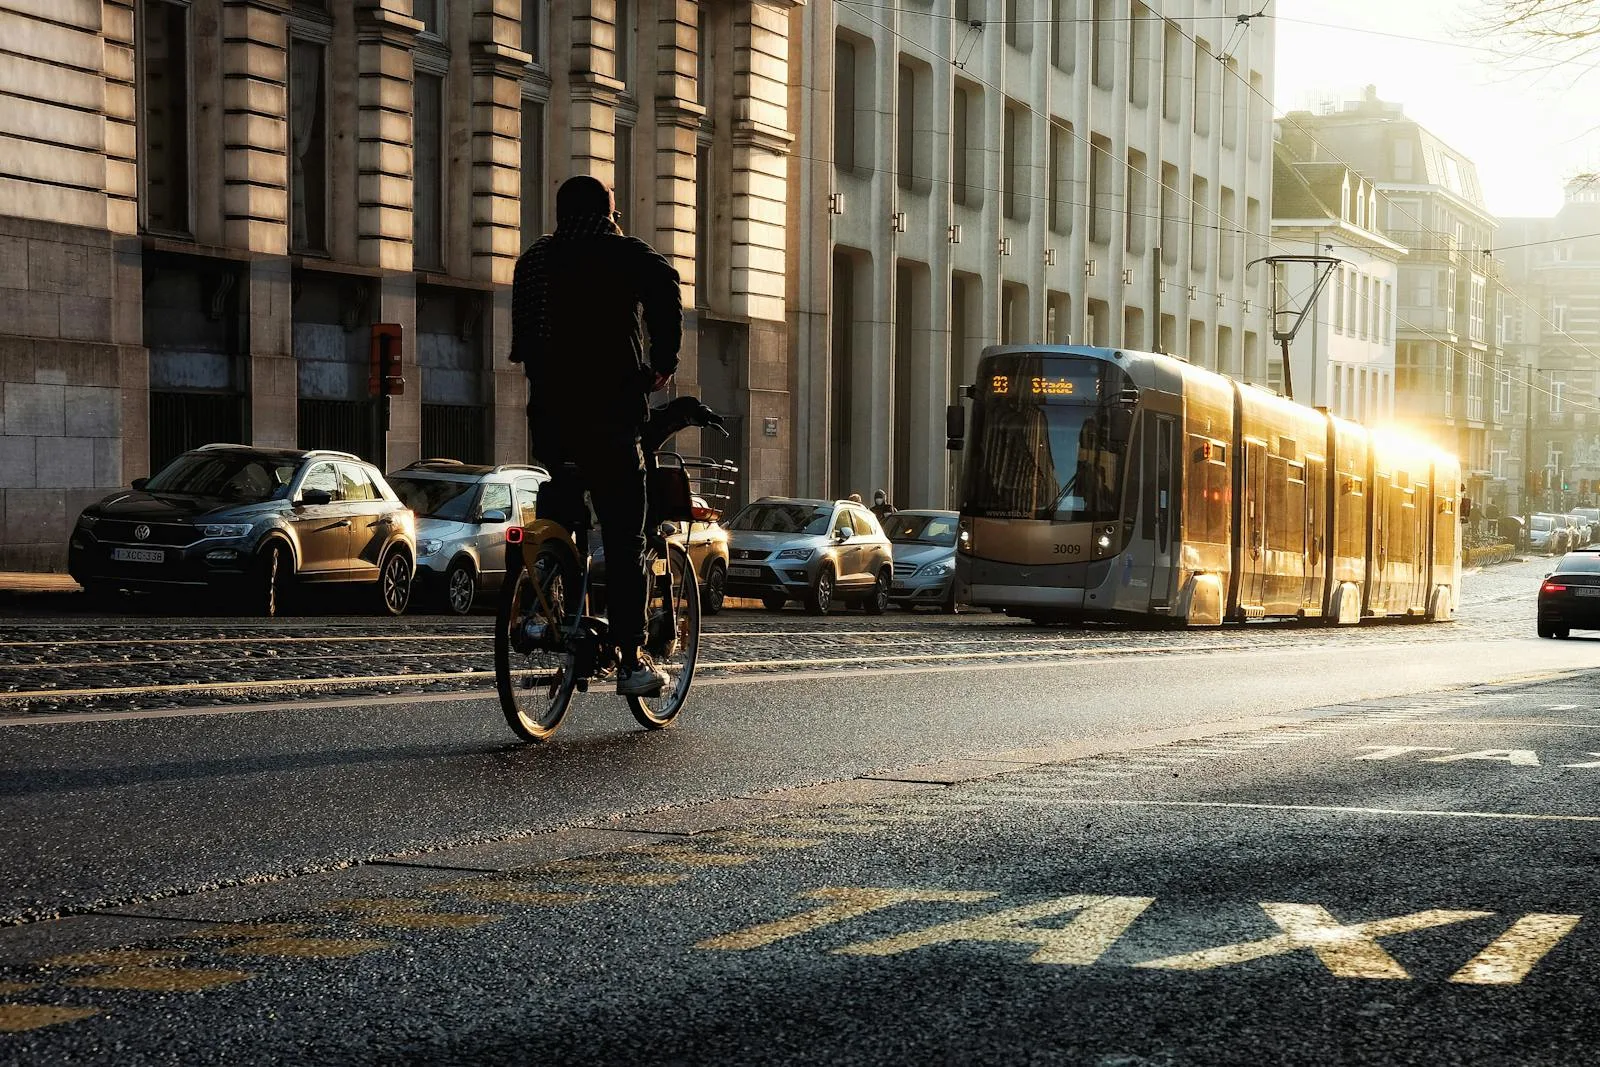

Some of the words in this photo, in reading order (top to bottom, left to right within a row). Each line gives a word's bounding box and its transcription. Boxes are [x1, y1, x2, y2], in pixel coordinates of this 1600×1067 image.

[993, 375, 1008, 393] 93
[1031, 377, 1073, 394] Stade
[1053, 543, 1081, 555] 3009
[693, 887, 1583, 985] TAXI
